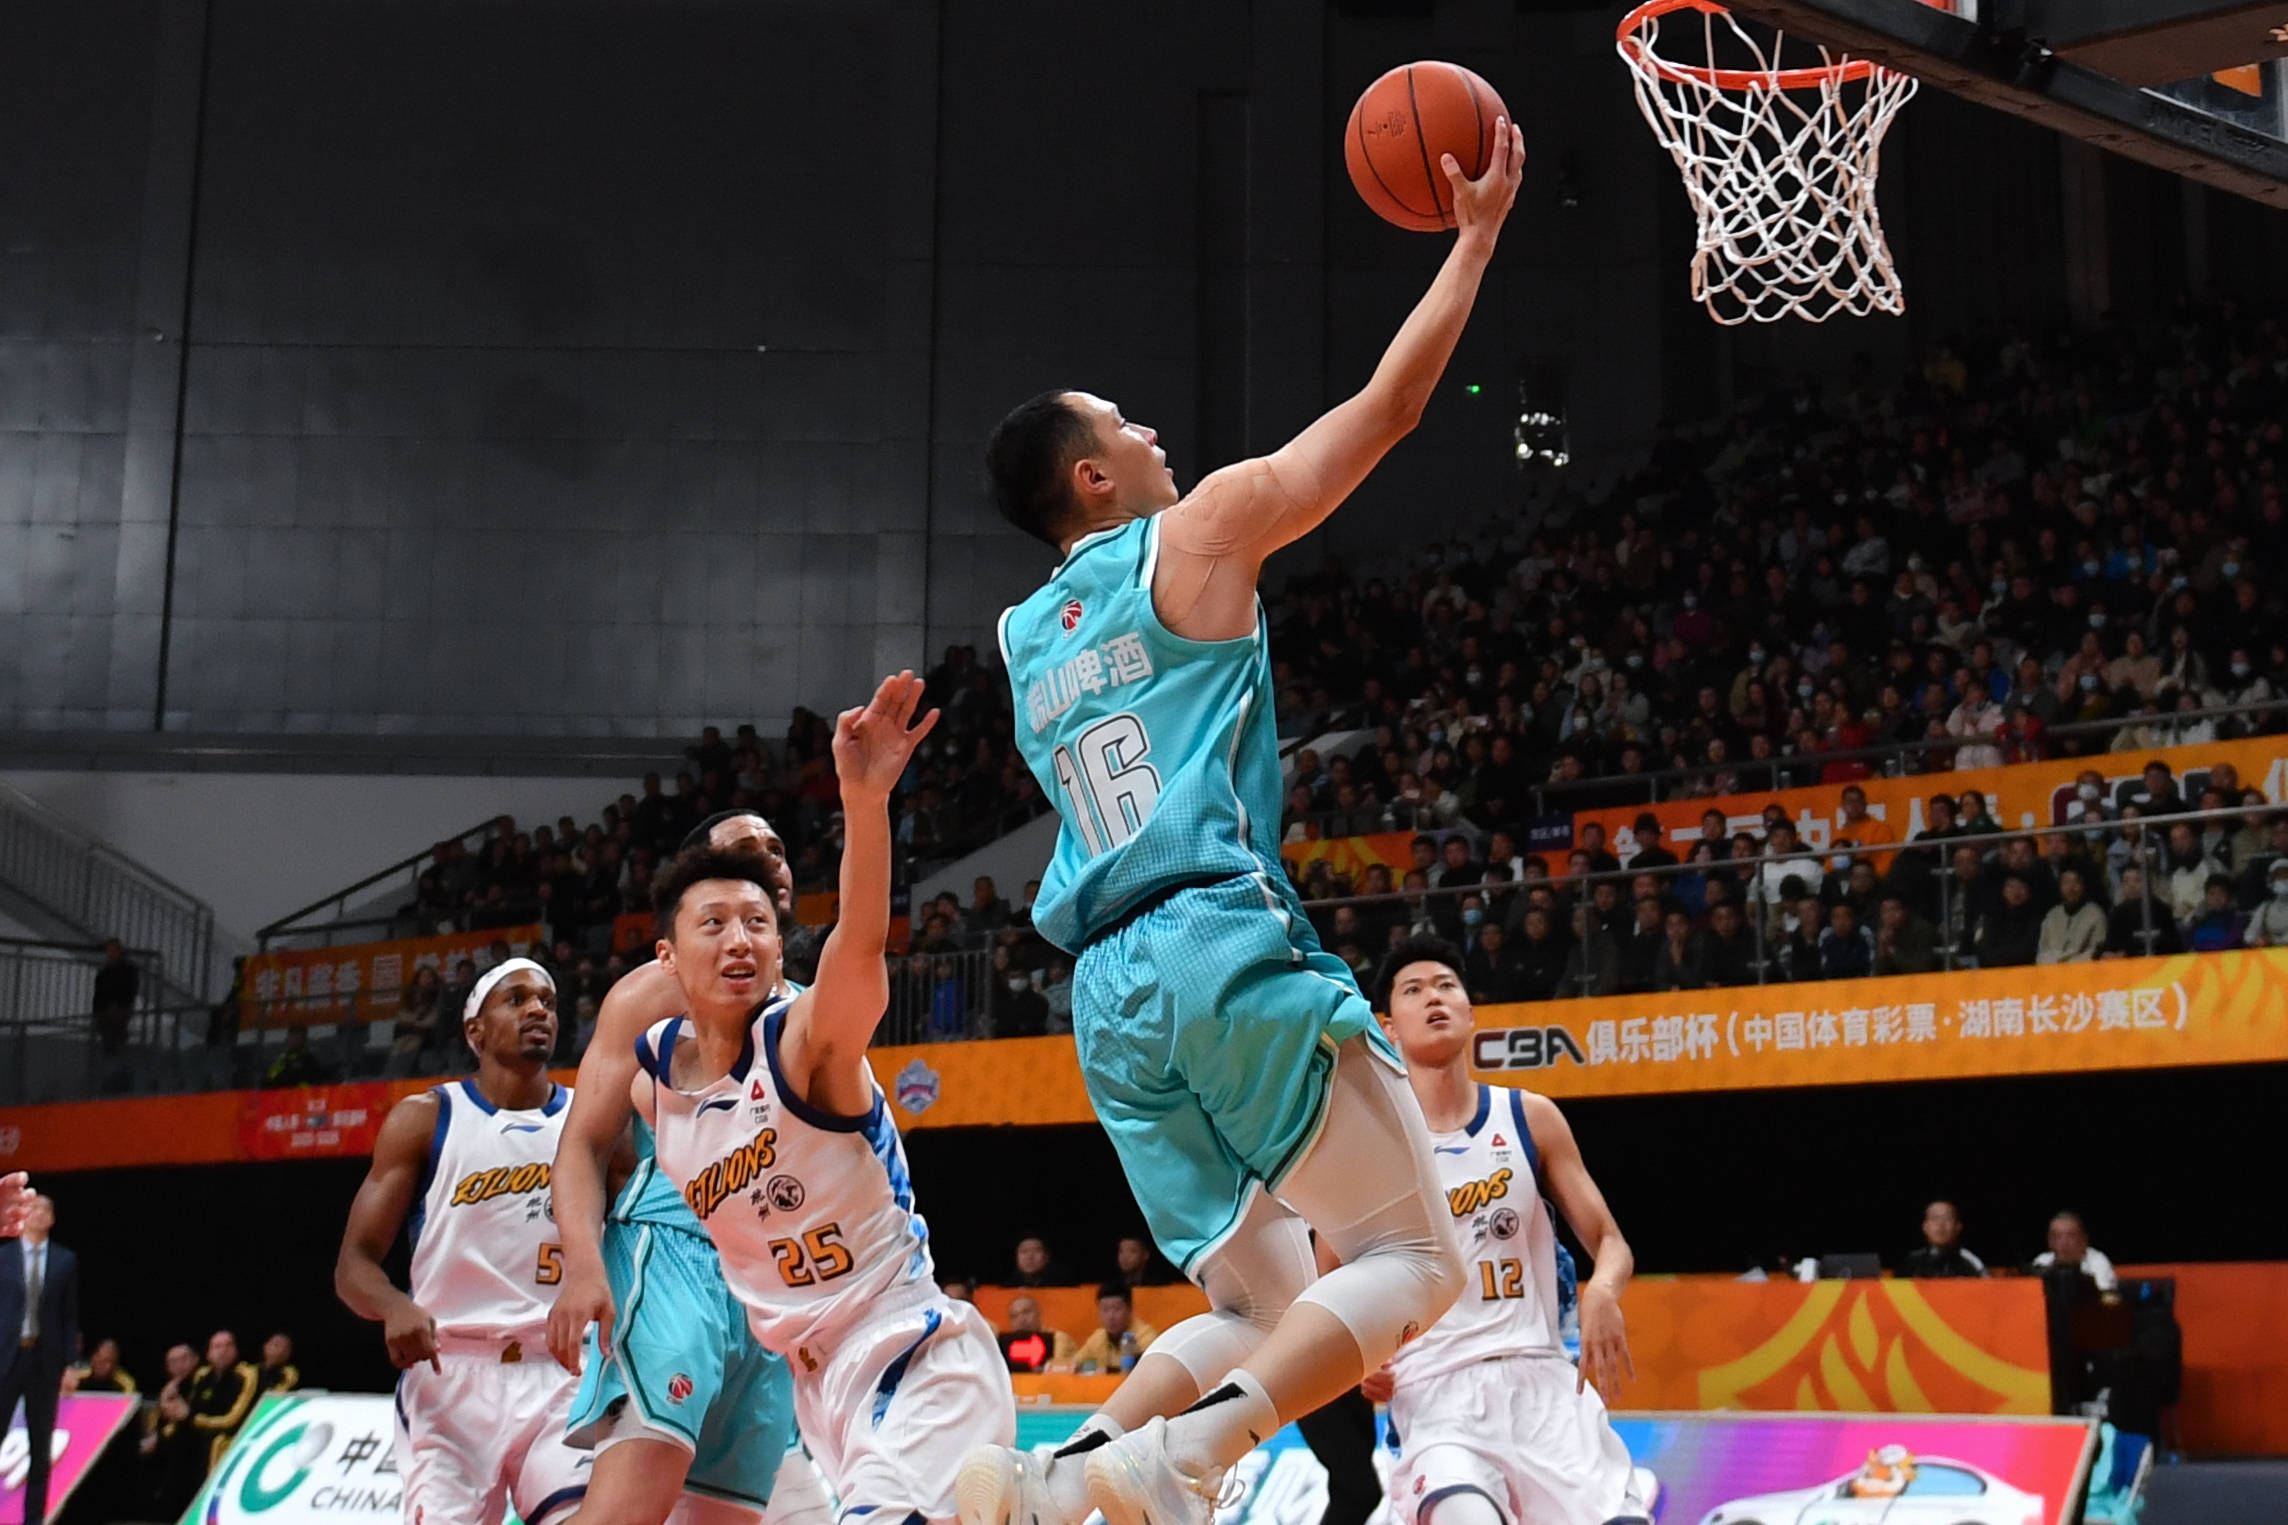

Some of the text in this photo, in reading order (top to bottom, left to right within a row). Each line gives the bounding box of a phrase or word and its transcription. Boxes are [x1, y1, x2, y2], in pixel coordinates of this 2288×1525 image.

[1054, 711, 1163, 858] 16
[1473, 1028, 1585, 1070] CBA
[535, 1242, 564, 1285] 5
[768, 1222, 854, 1288] 25
[1479, 1258, 1524, 1301] 12
[311, 1486, 402, 1511] CHINA
